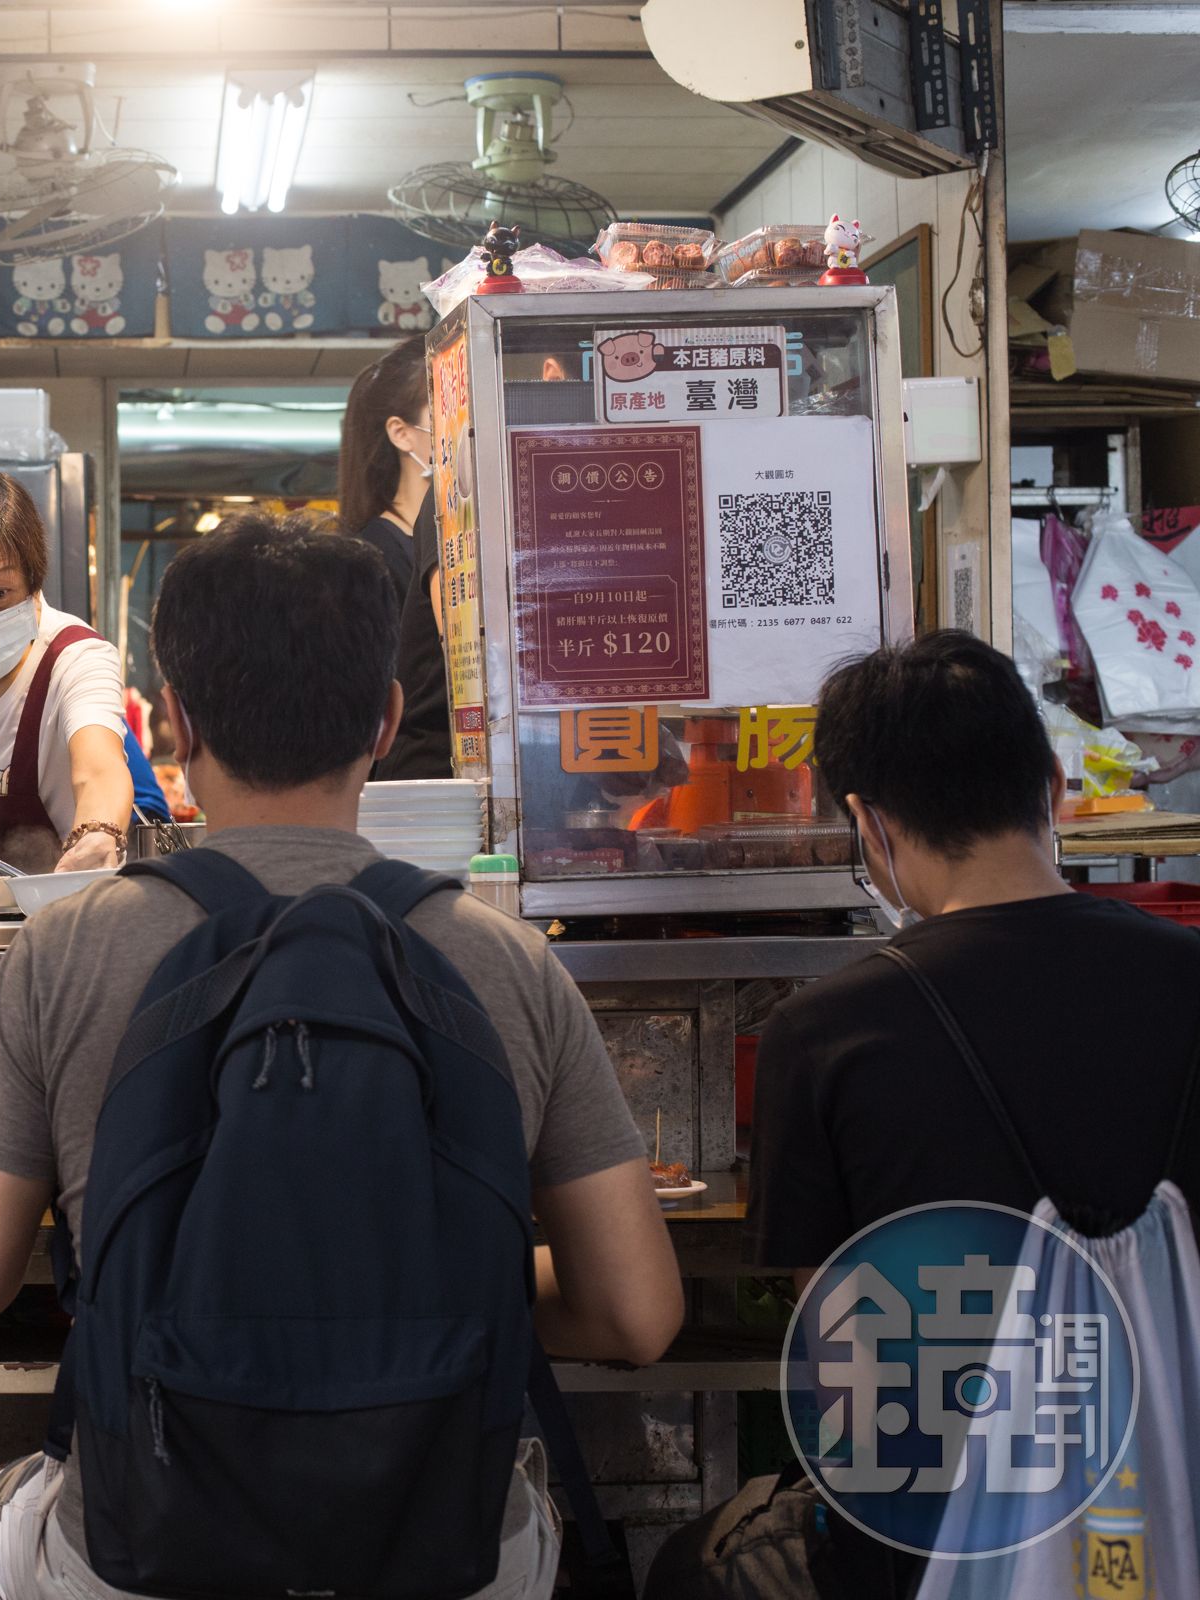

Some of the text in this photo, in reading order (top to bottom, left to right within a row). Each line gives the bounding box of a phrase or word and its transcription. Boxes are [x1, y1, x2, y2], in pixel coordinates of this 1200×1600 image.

[673, 347, 765, 367] 本店豬原料
[610, 378, 758, 411] 原產地 臺灣
[555, 467, 660, 487] 調價公告
[573, 590, 648, 604] 自9月10日起
[556, 613, 668, 627] 豬肝腸半斤以上恢復原價
[784, 618, 805, 626] 6077
[810, 617, 831, 625] 0487
[836, 616, 852, 624] 622
[558, 631, 671, 658] 半斤 $120
[1091, 1536, 1139, 1591] AFA
